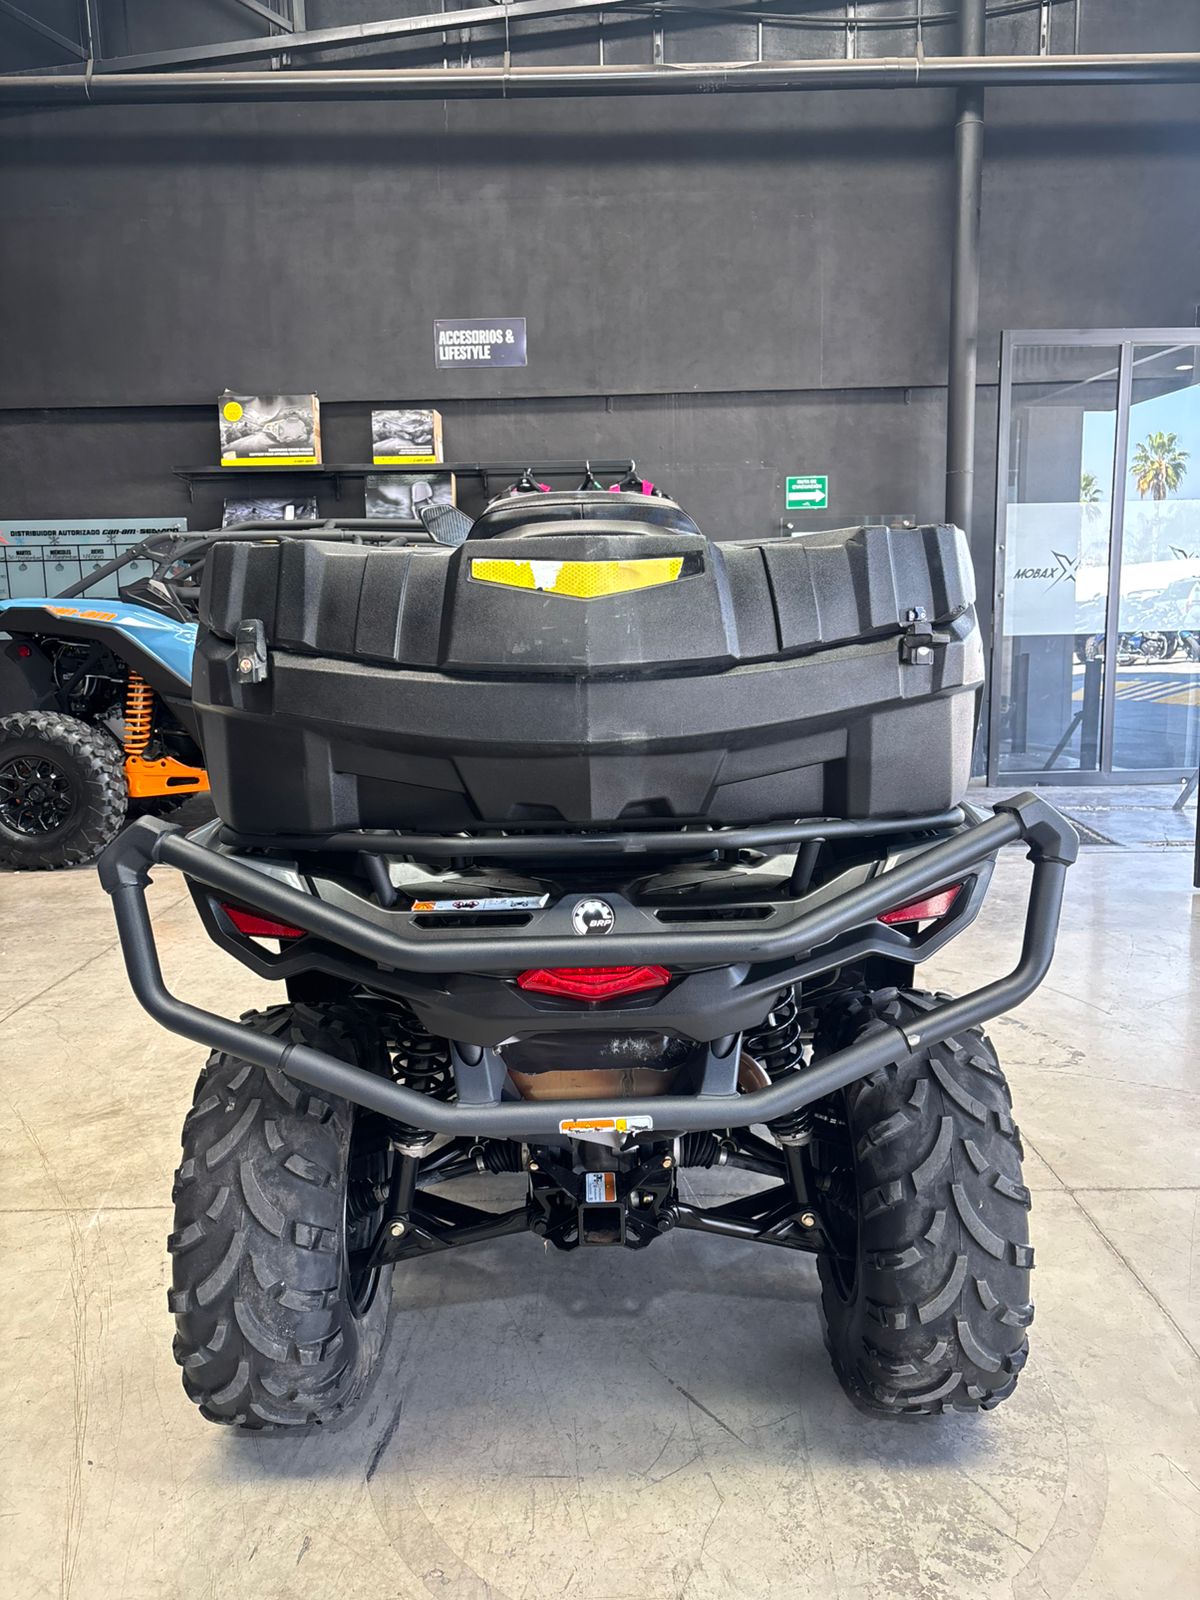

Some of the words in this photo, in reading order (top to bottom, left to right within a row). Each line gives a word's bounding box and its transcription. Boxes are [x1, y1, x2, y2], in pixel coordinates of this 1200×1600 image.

[439, 329, 504, 345] ACCESORIOS
[505, 329, 515, 344] &
[439, 345, 491, 360] LIFESTYLE
[1013, 568, 1059, 579] MOBAX
[589, 919, 612, 928] BRP
